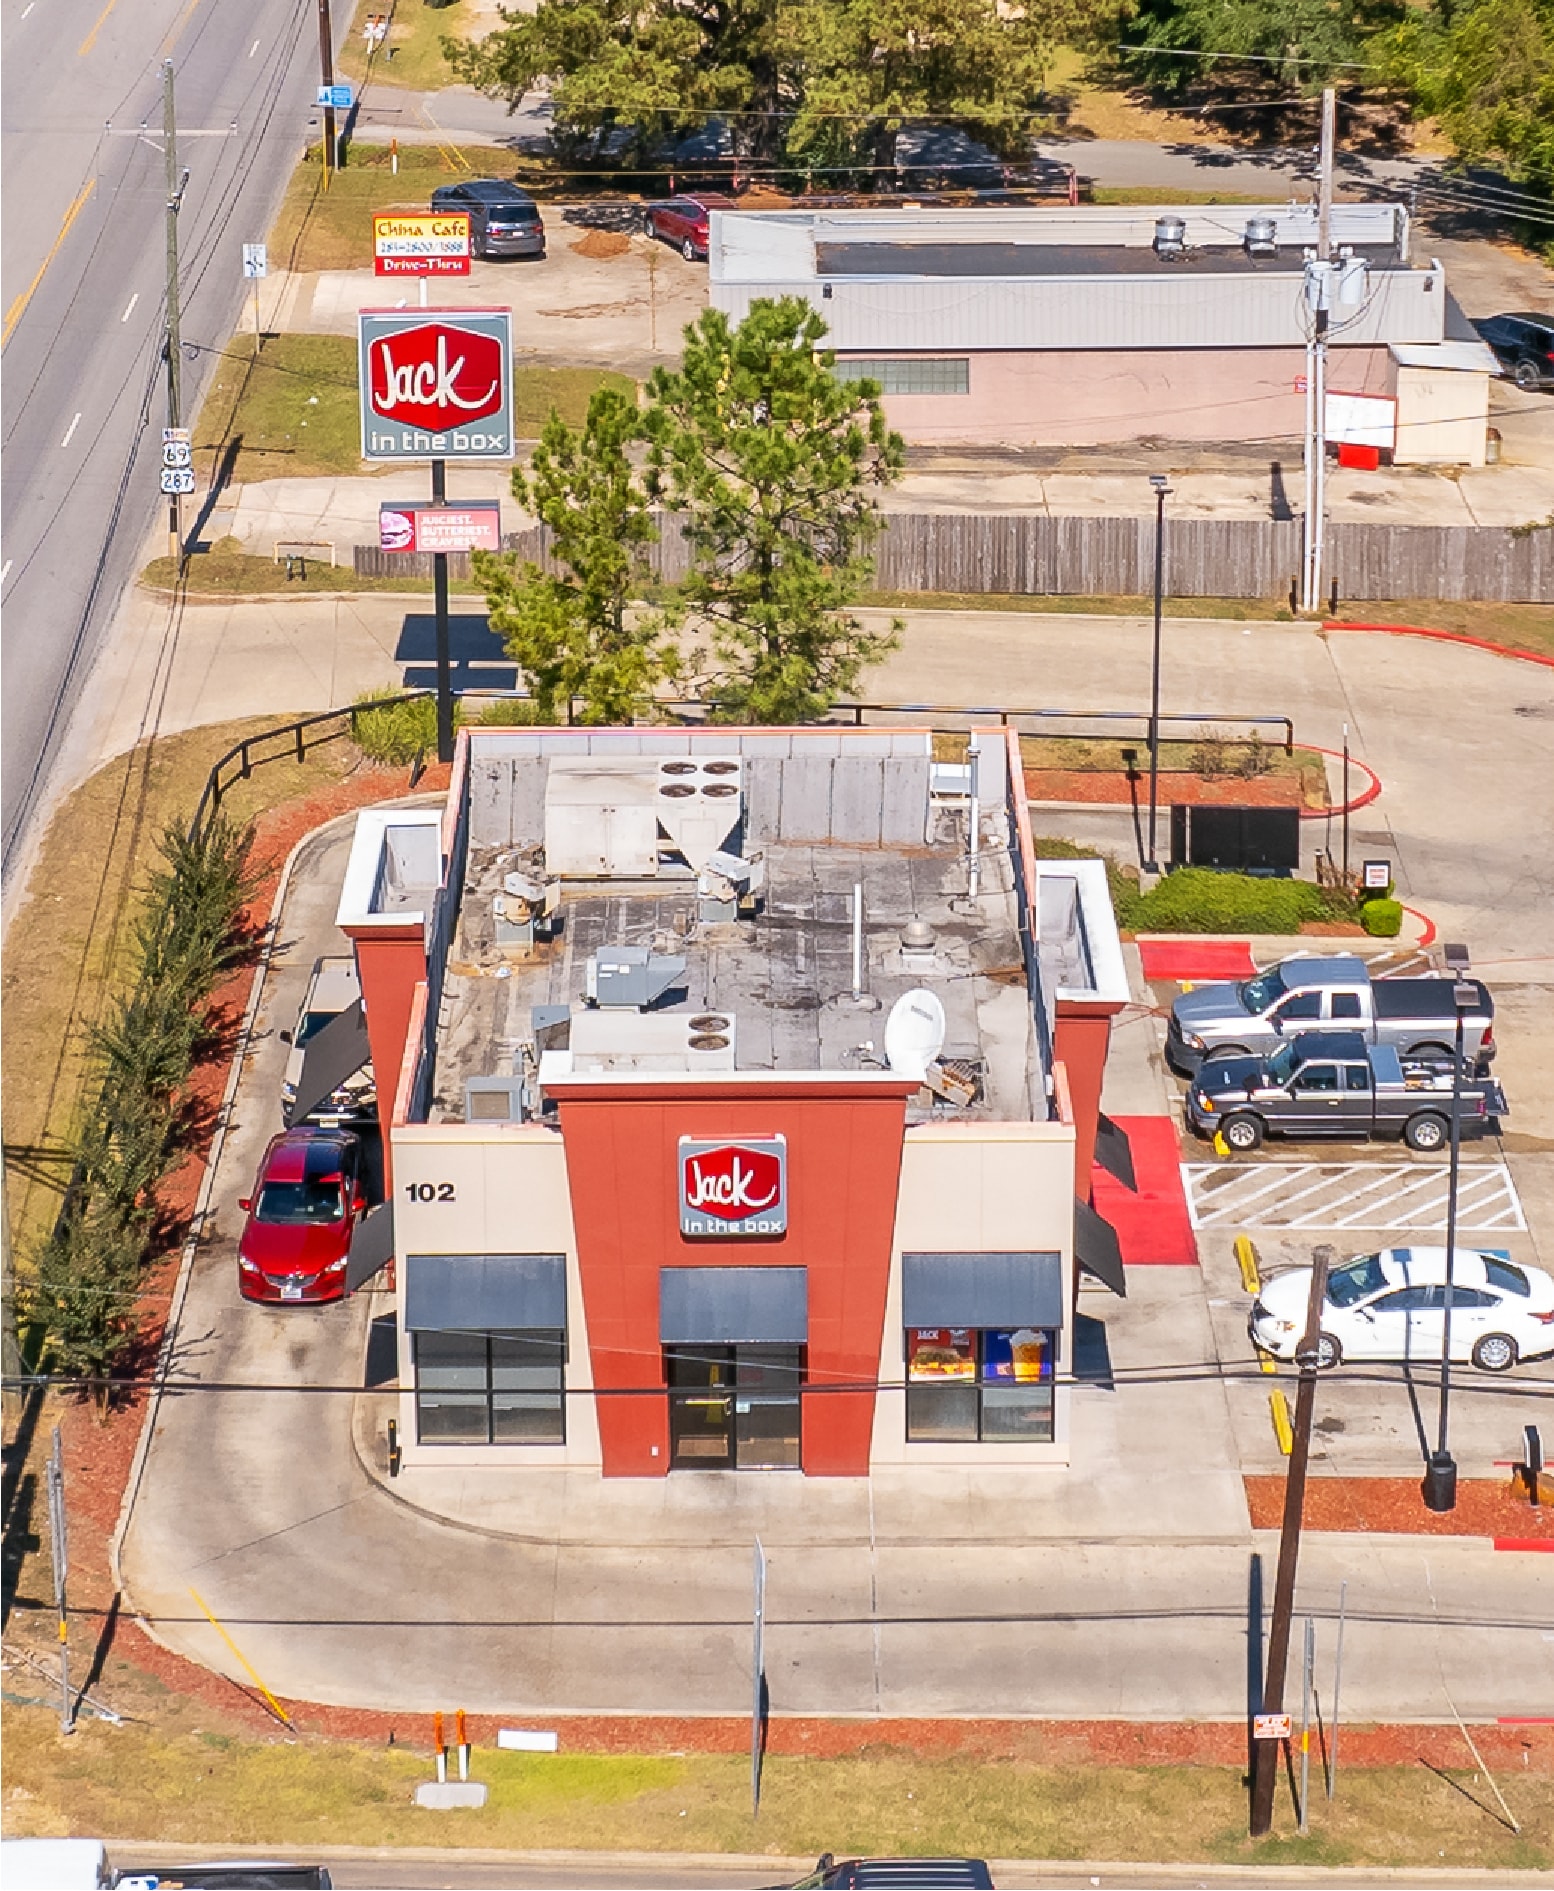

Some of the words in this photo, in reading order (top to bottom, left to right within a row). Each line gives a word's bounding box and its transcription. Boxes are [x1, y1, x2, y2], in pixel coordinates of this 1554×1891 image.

[377, 221, 423, 236] China
[432, 221, 466, 236] Cafe
[383, 258, 463, 271] Drive-Thru
[374, 335, 498, 410] Jack
[371, 431, 395, 451] in
[402, 431, 447, 451] the
[453, 431, 506, 450] box
[166, 448, 187, 462] 69
[164, 473, 192, 489] 287
[687, 1156, 778, 1207] Jack
[405, 1183, 457, 1202] 102
[684, 1218, 703, 1233] in
[707, 1218, 740, 1233] the
[745, 1218, 782, 1233] box
